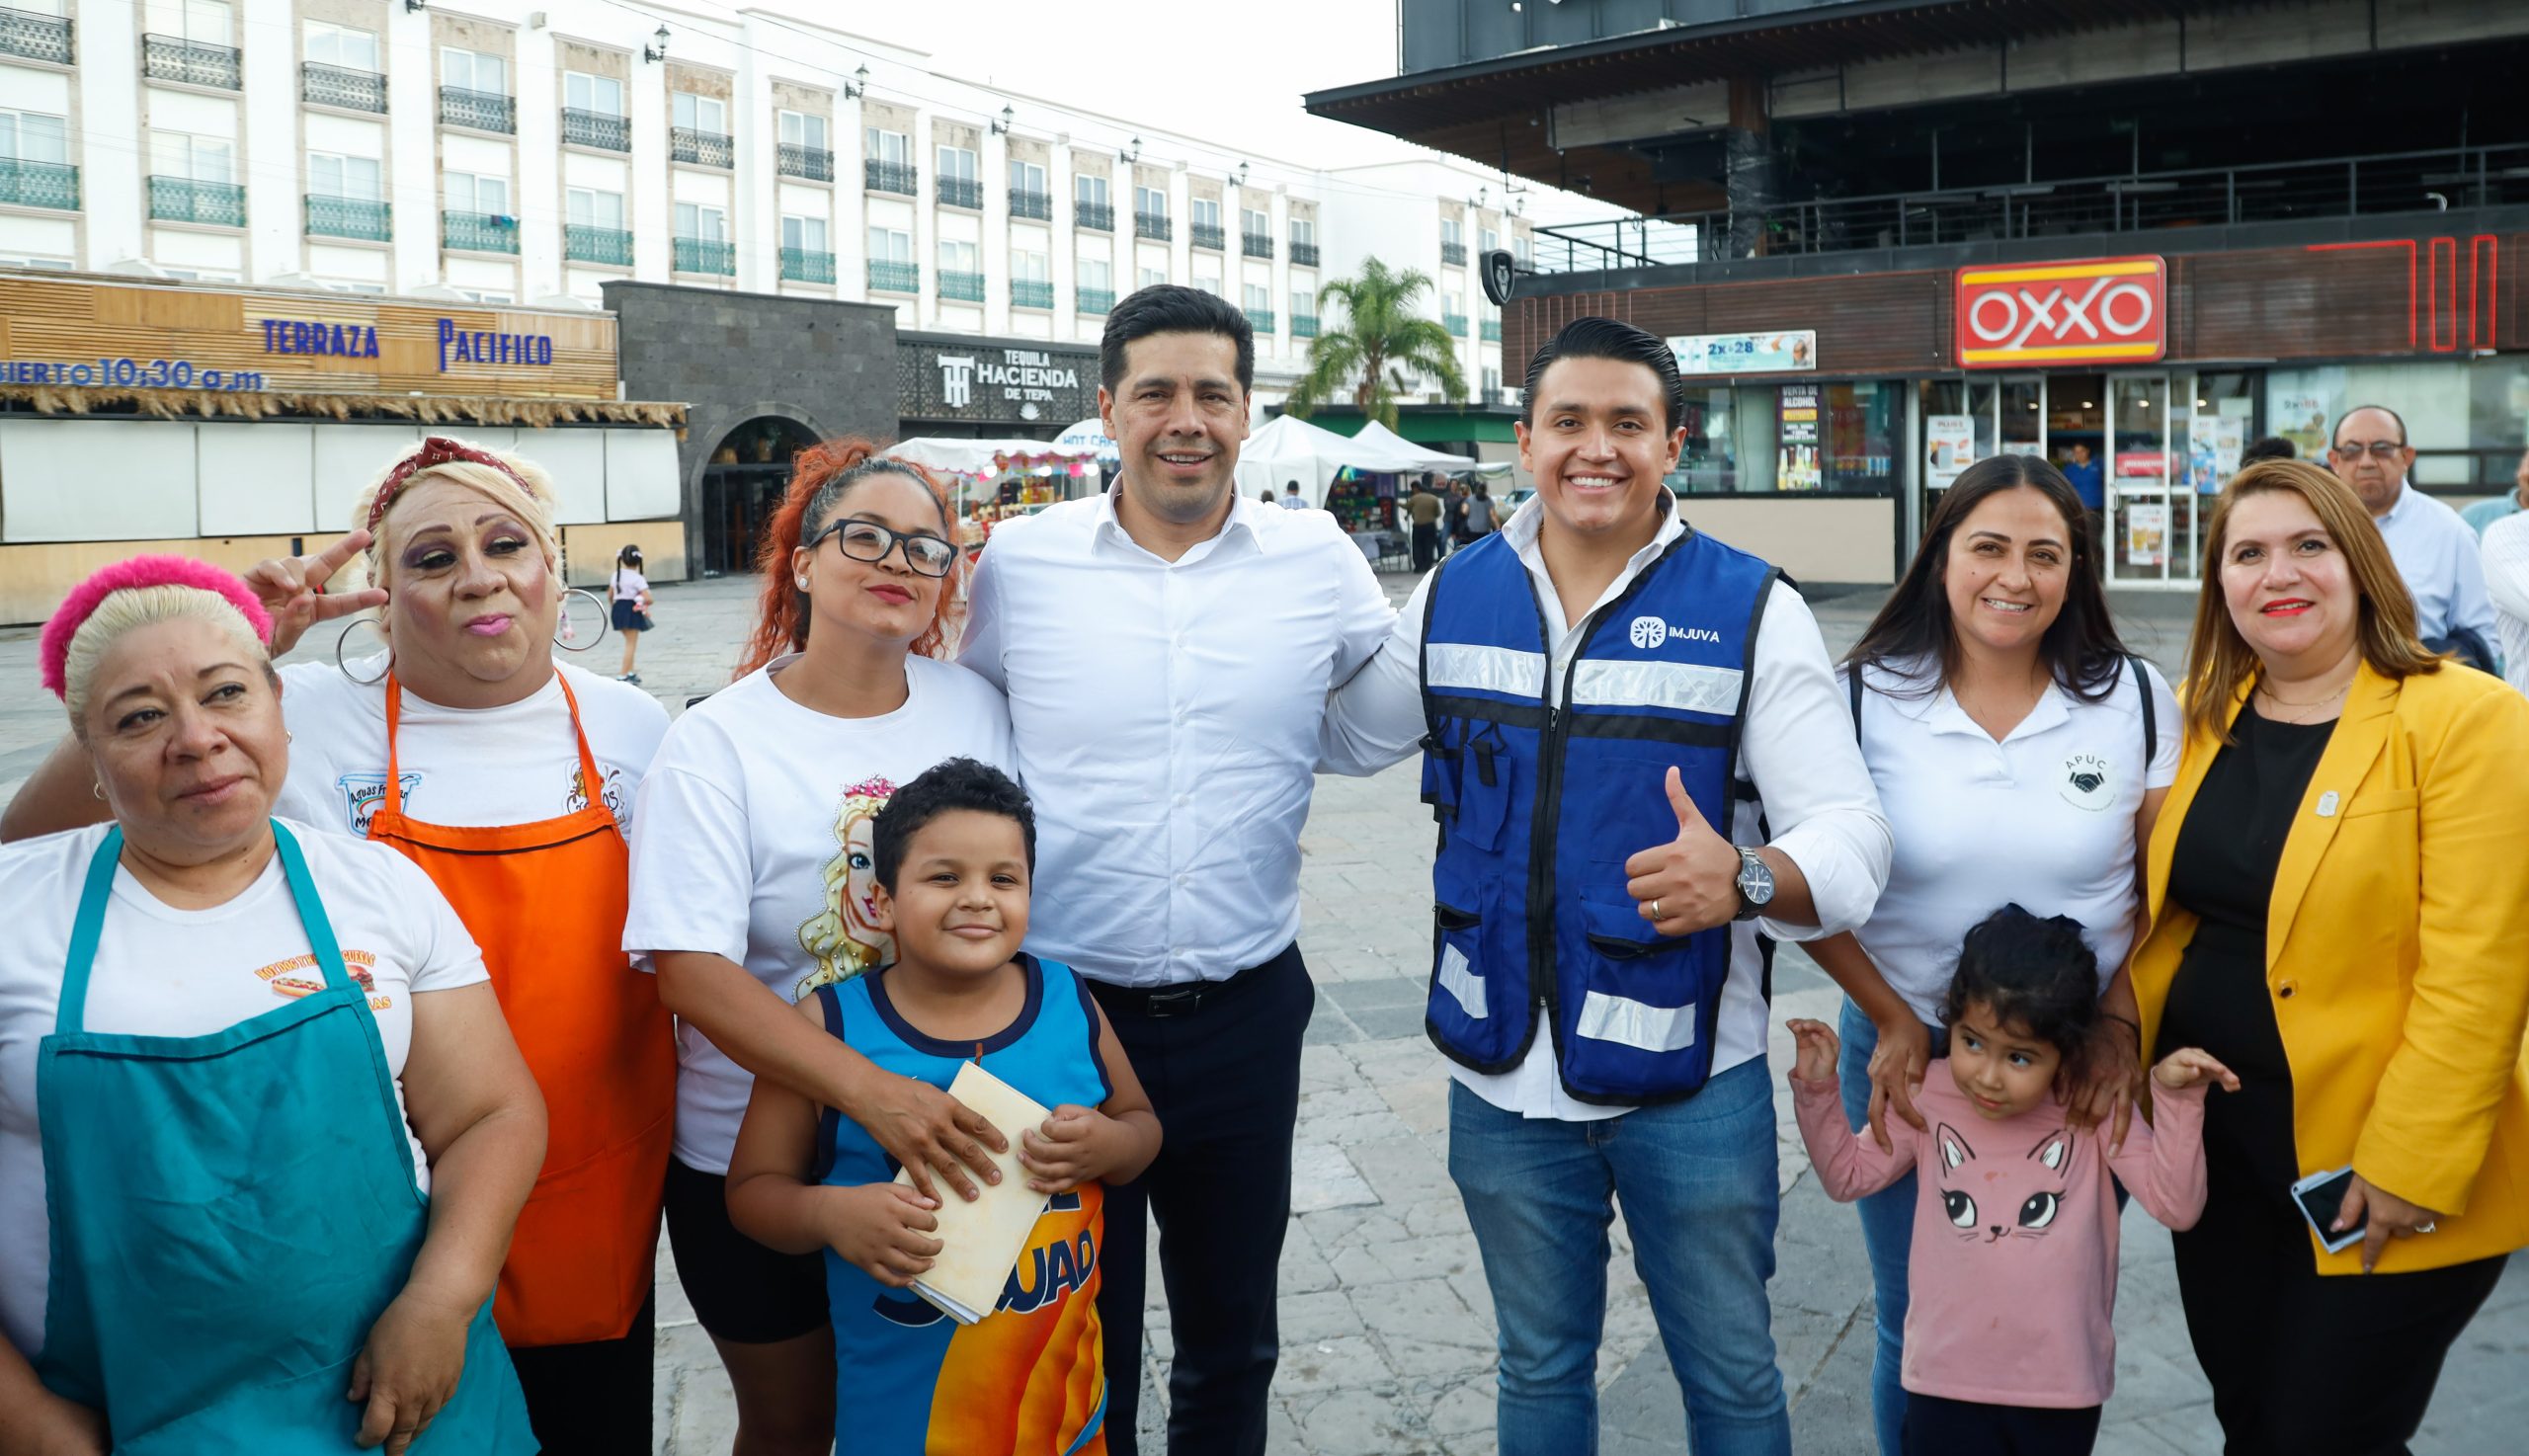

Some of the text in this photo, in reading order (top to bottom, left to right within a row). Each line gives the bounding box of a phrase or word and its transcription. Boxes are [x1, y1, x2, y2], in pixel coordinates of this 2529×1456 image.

[1969, 276, 2154, 351] OXXO
[261, 317, 553, 372] TERRAZA PACIFICO
[1004, 349, 1051, 367] TEQUILA
[98, 357, 194, 388] 10:30
[976, 362, 1080, 389] HACIENDA
[1004, 387, 1054, 402] DE TEPA
[1783, 396, 1818, 408] ALCOHOL
[1669, 626, 1720, 643] IMJUVA
[2066, 754, 2107, 770] APUC
[253, 964, 281, 981] HOT
